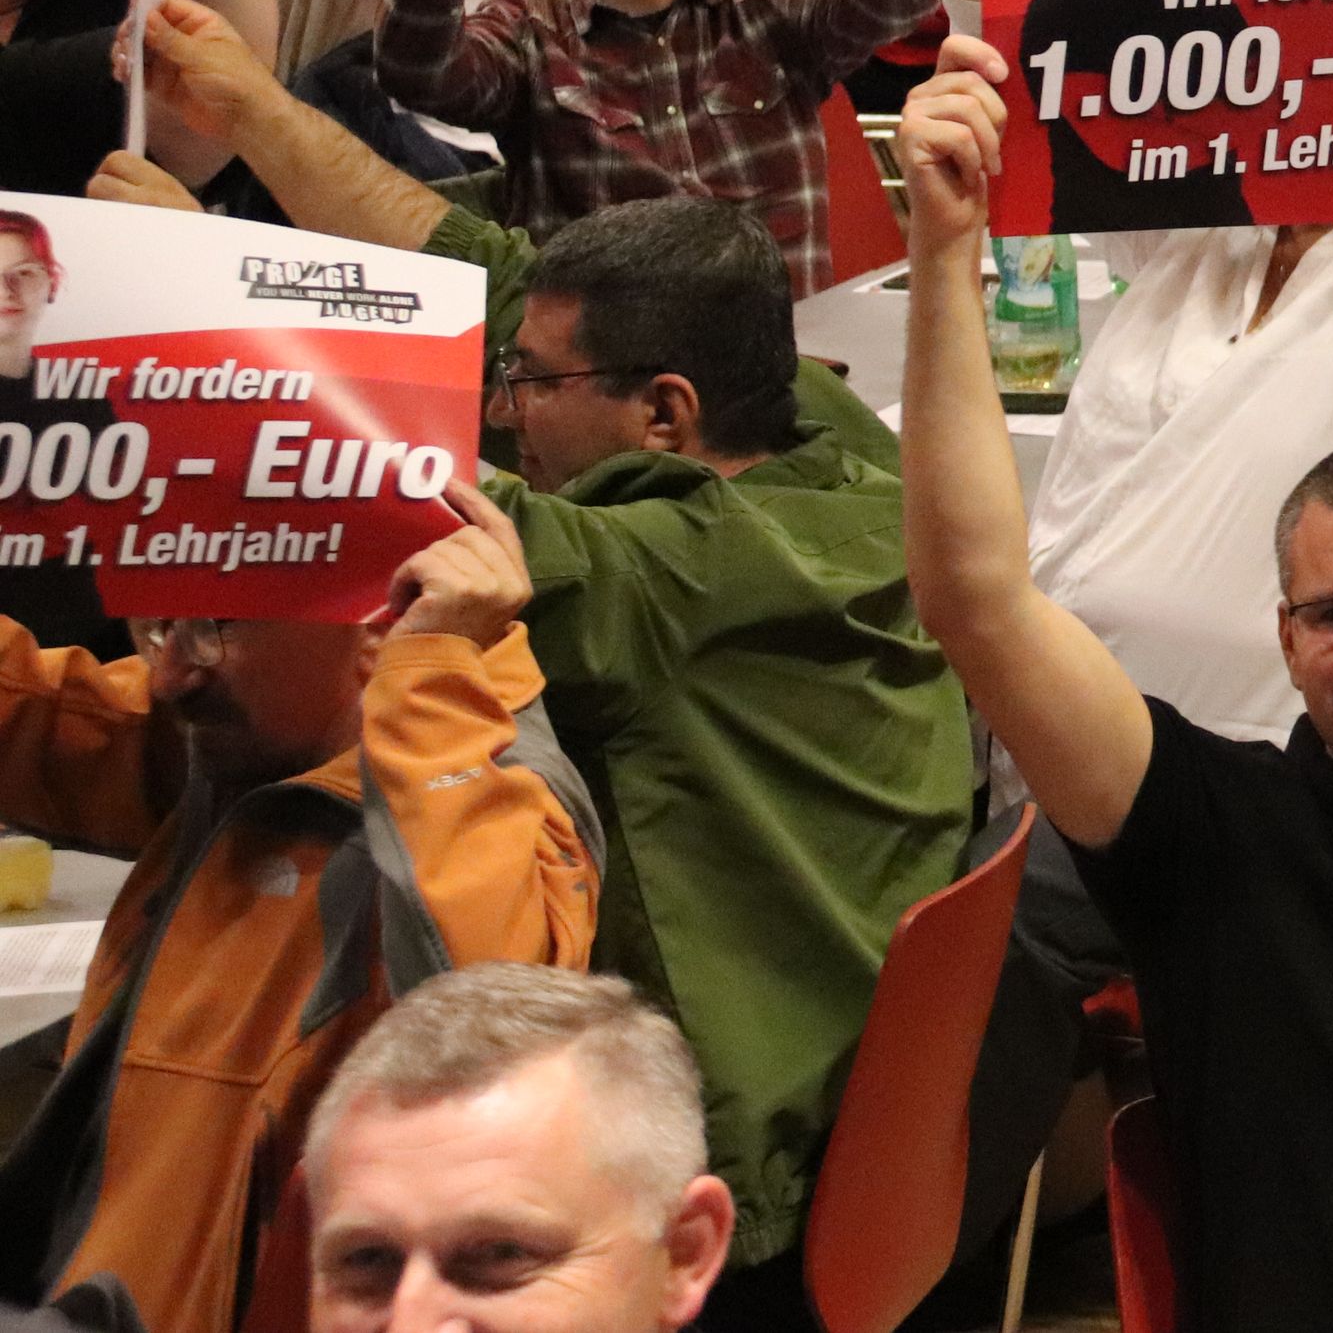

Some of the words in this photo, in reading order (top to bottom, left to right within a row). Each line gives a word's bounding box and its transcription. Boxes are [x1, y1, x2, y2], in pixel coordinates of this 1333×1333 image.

[1127, 138, 1189, 183] im
[1208, 130, 1248, 176] 1.
[308, 290, 344, 300] NEVER
[379, 296, 414, 305] ALONE
[35, 357, 118, 400] Wir
[130, 358, 314, 401] fordern
[244, 420, 455, 500] Euro
[64, 526, 103, 566] 1.
[119, 522, 345, 573] Lehrjahr!
